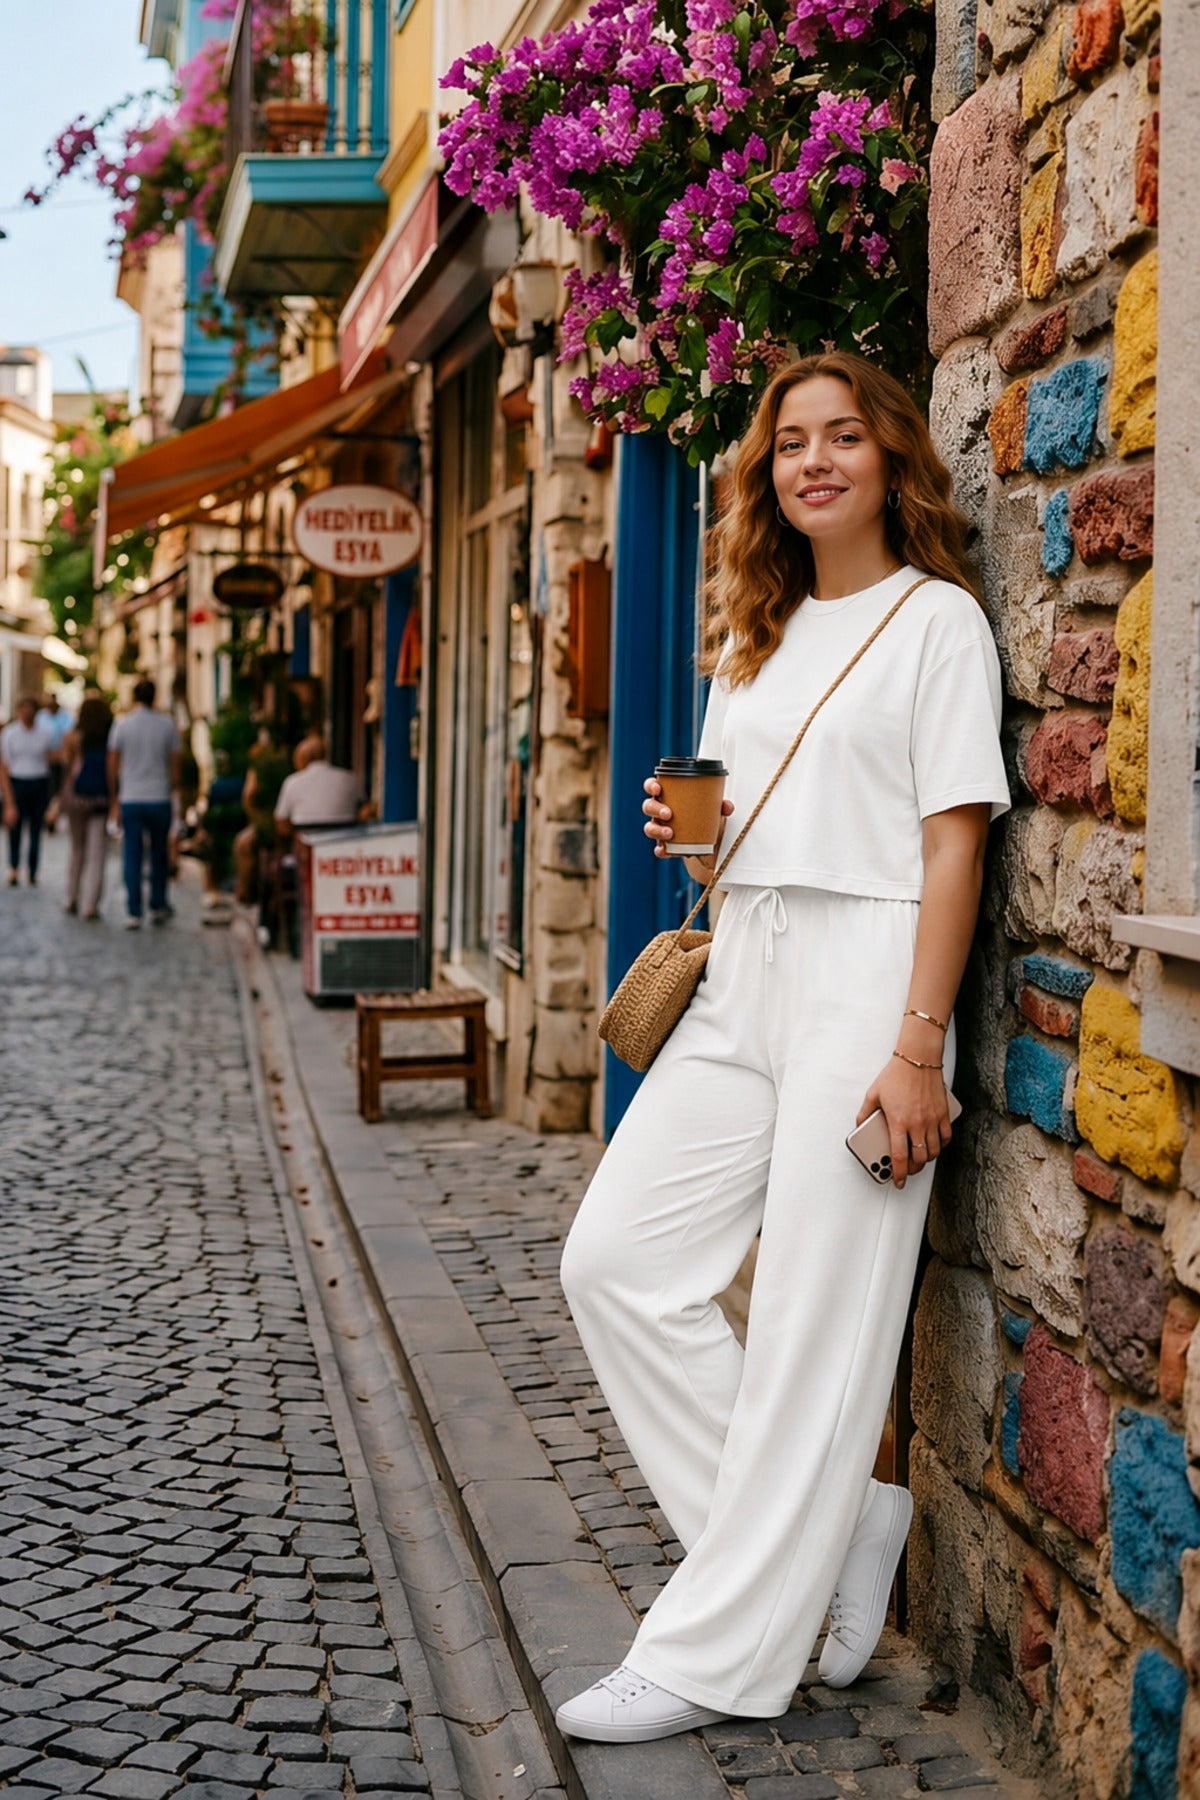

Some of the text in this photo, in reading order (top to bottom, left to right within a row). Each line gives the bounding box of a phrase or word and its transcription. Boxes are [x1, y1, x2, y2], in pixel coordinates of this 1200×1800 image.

[304, 503, 413, 533] HEDİYELİK
[334, 540, 382, 565] EŞYA
[345, 885, 393, 907] EŞYA
